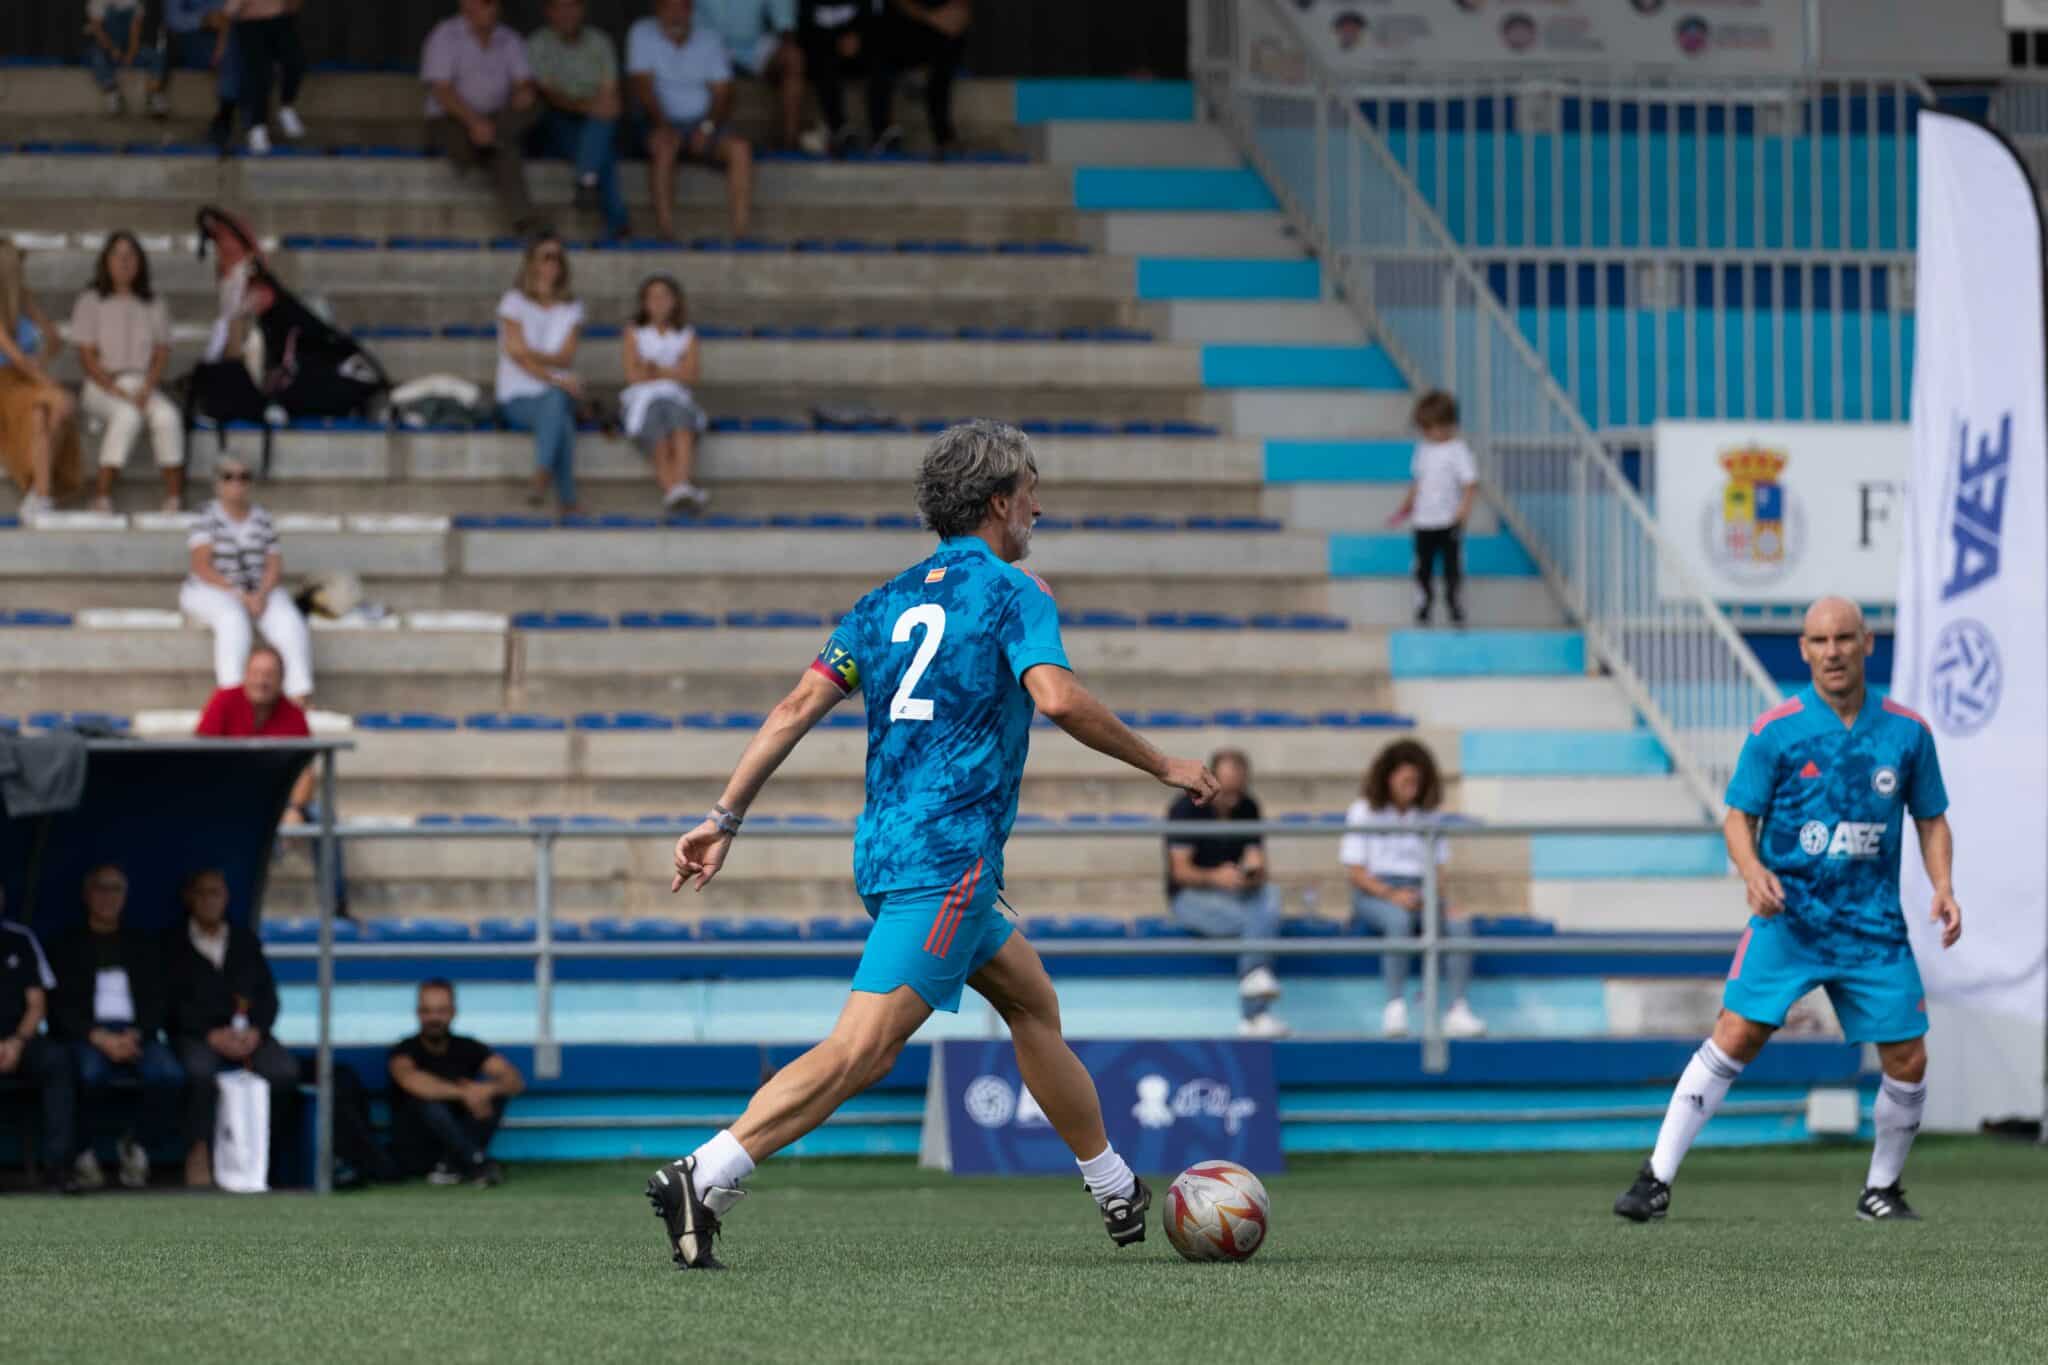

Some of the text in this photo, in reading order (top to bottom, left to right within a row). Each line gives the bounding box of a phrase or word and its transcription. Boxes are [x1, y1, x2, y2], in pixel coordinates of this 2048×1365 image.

[1858, 481, 1898, 549] F
[890, 603, 946, 722] 2
[1828, 821, 1888, 856] AFE
